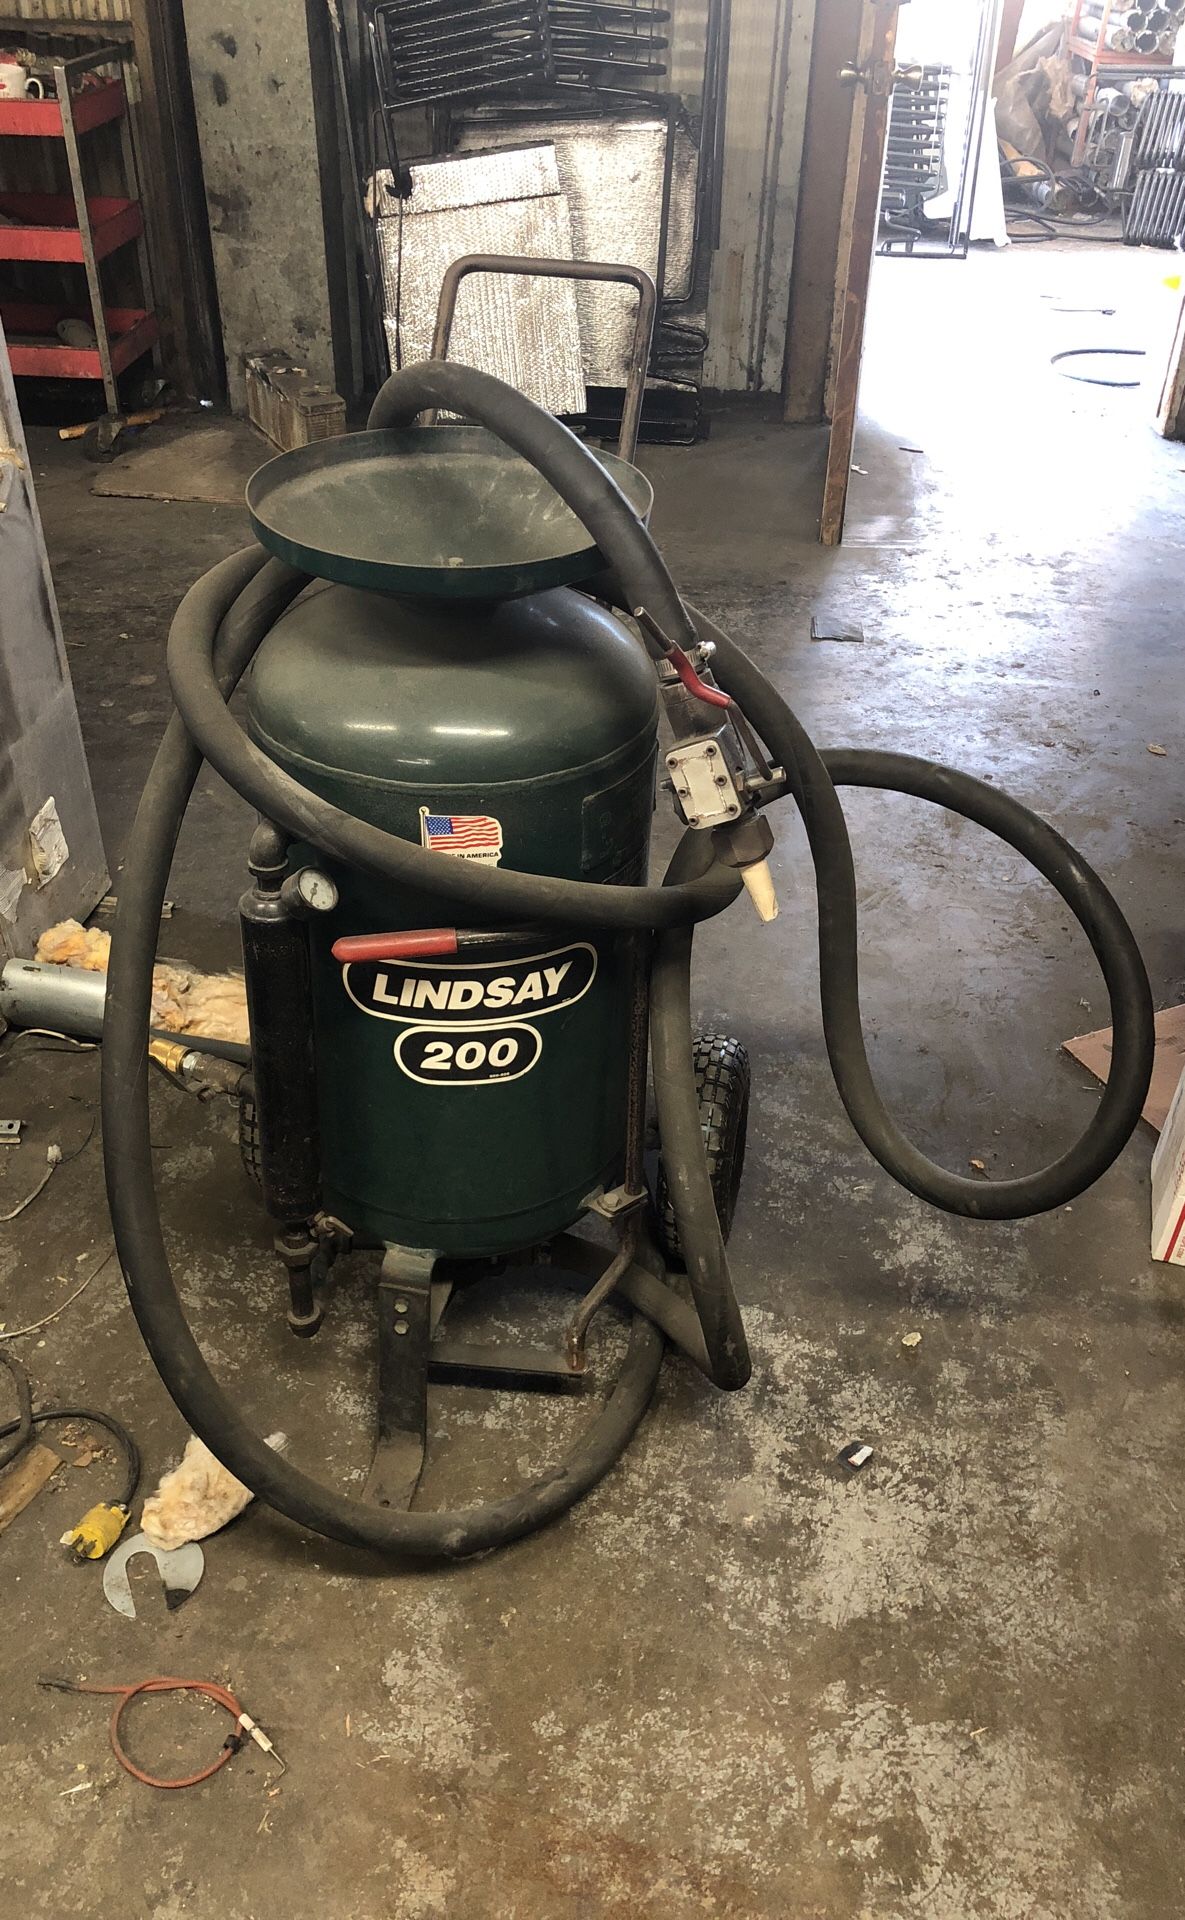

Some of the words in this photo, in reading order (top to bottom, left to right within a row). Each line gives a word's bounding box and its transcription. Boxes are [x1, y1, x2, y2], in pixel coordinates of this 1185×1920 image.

[466, 851, 499, 859] AMERICA
[373, 961, 573, 1010] LINDSAY
[420, 1038, 518, 1070] 200
